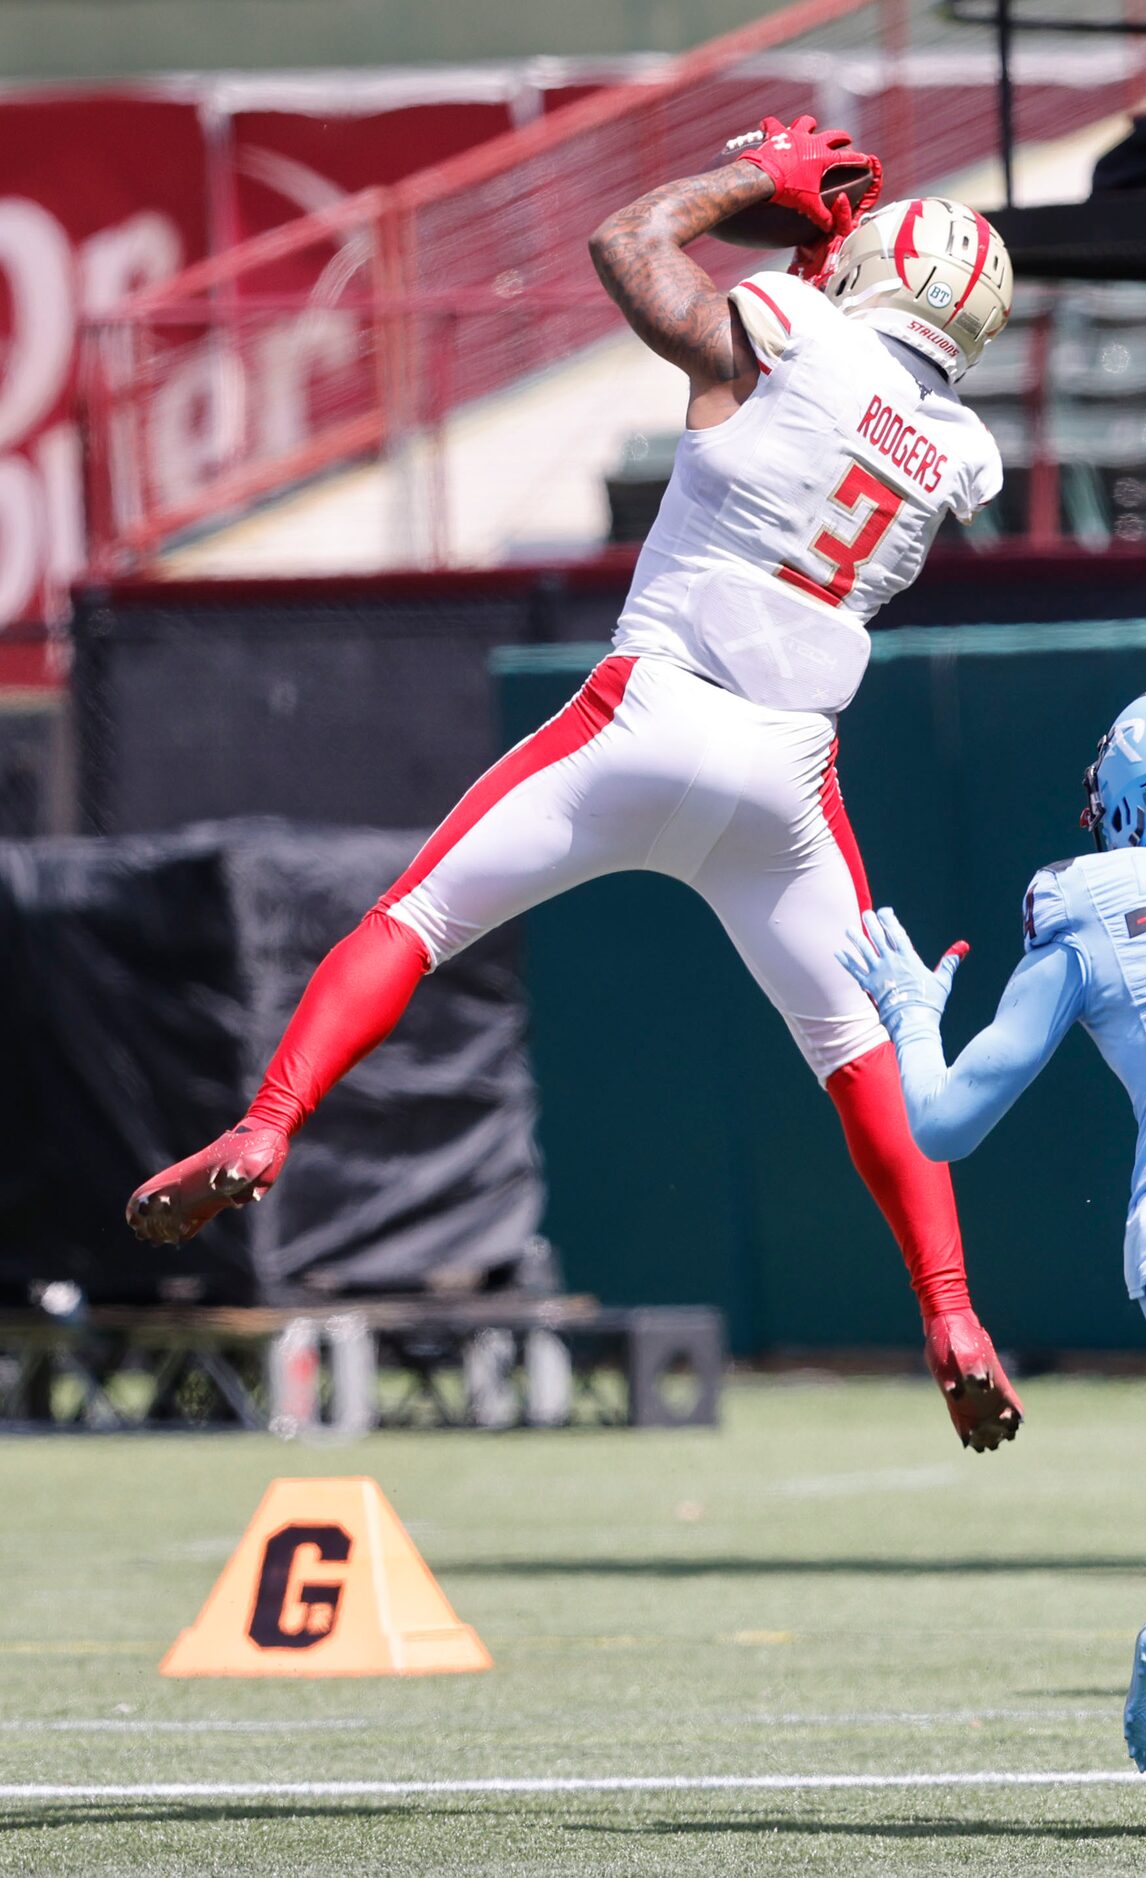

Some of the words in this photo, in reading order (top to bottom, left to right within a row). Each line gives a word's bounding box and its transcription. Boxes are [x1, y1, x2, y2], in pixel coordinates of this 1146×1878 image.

[907, 320, 960, 358] STALLIONS
[929, 286, 950, 303] BT
[856, 394, 948, 494] RODGERS
[772, 458, 907, 609] 3
[246, 1524, 354, 1650] G
